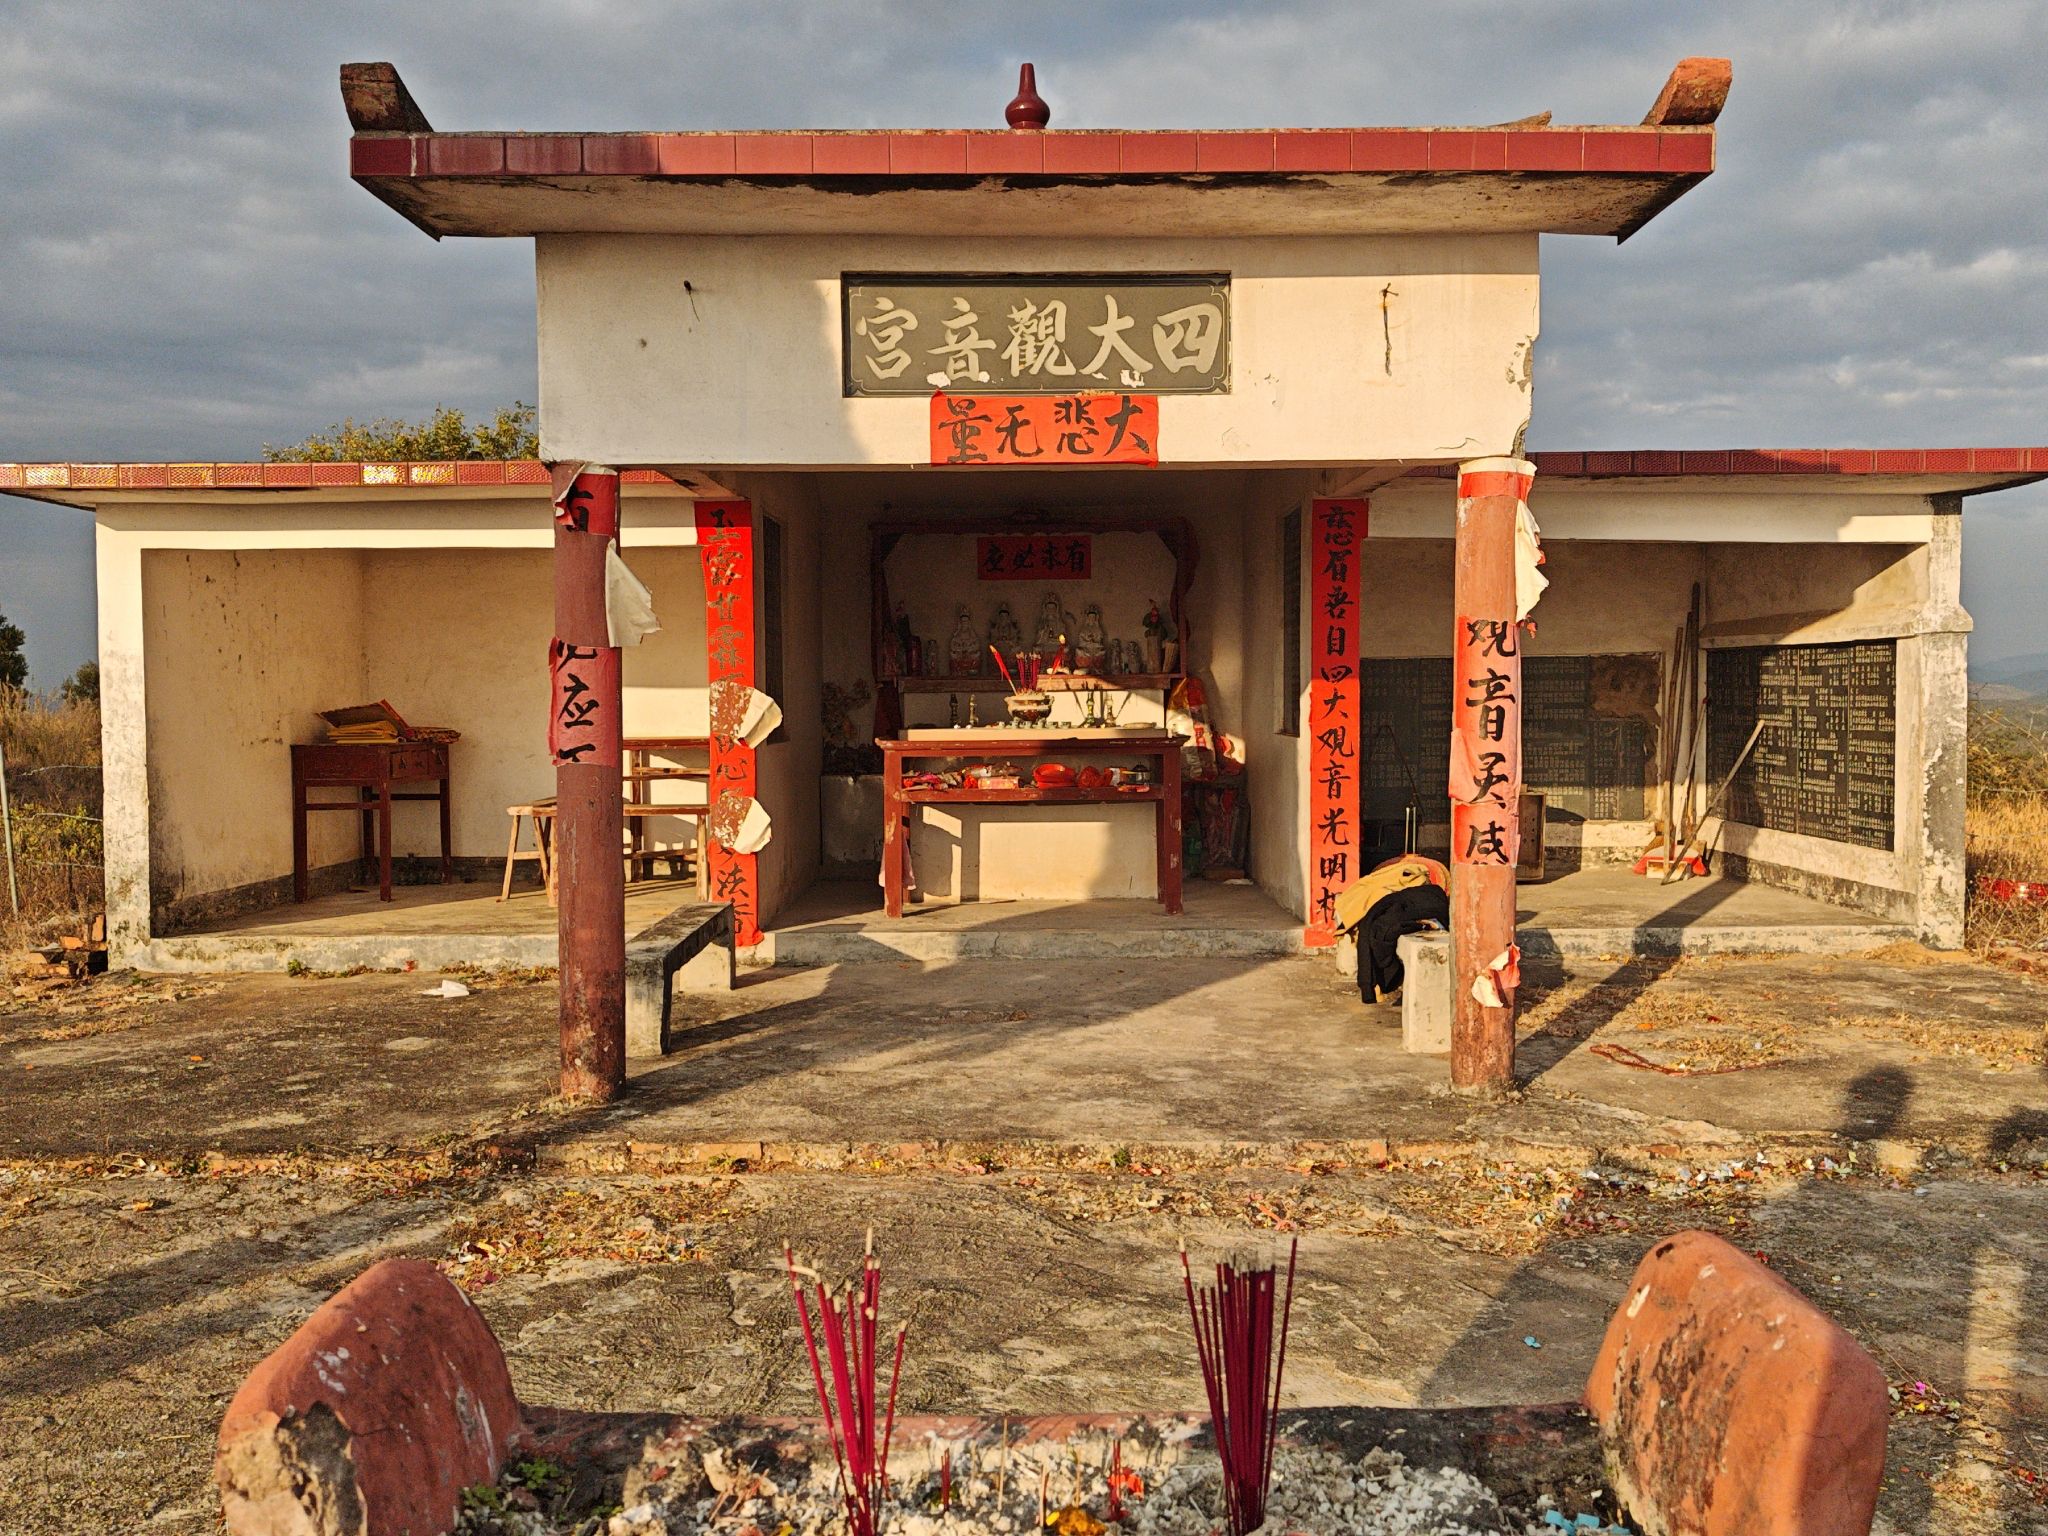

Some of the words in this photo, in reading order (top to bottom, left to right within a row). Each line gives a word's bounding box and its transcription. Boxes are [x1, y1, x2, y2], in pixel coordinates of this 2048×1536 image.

[856, 294, 1222, 381] 四大觀音宮
[937, 395, 1150, 464] 大悲无量
